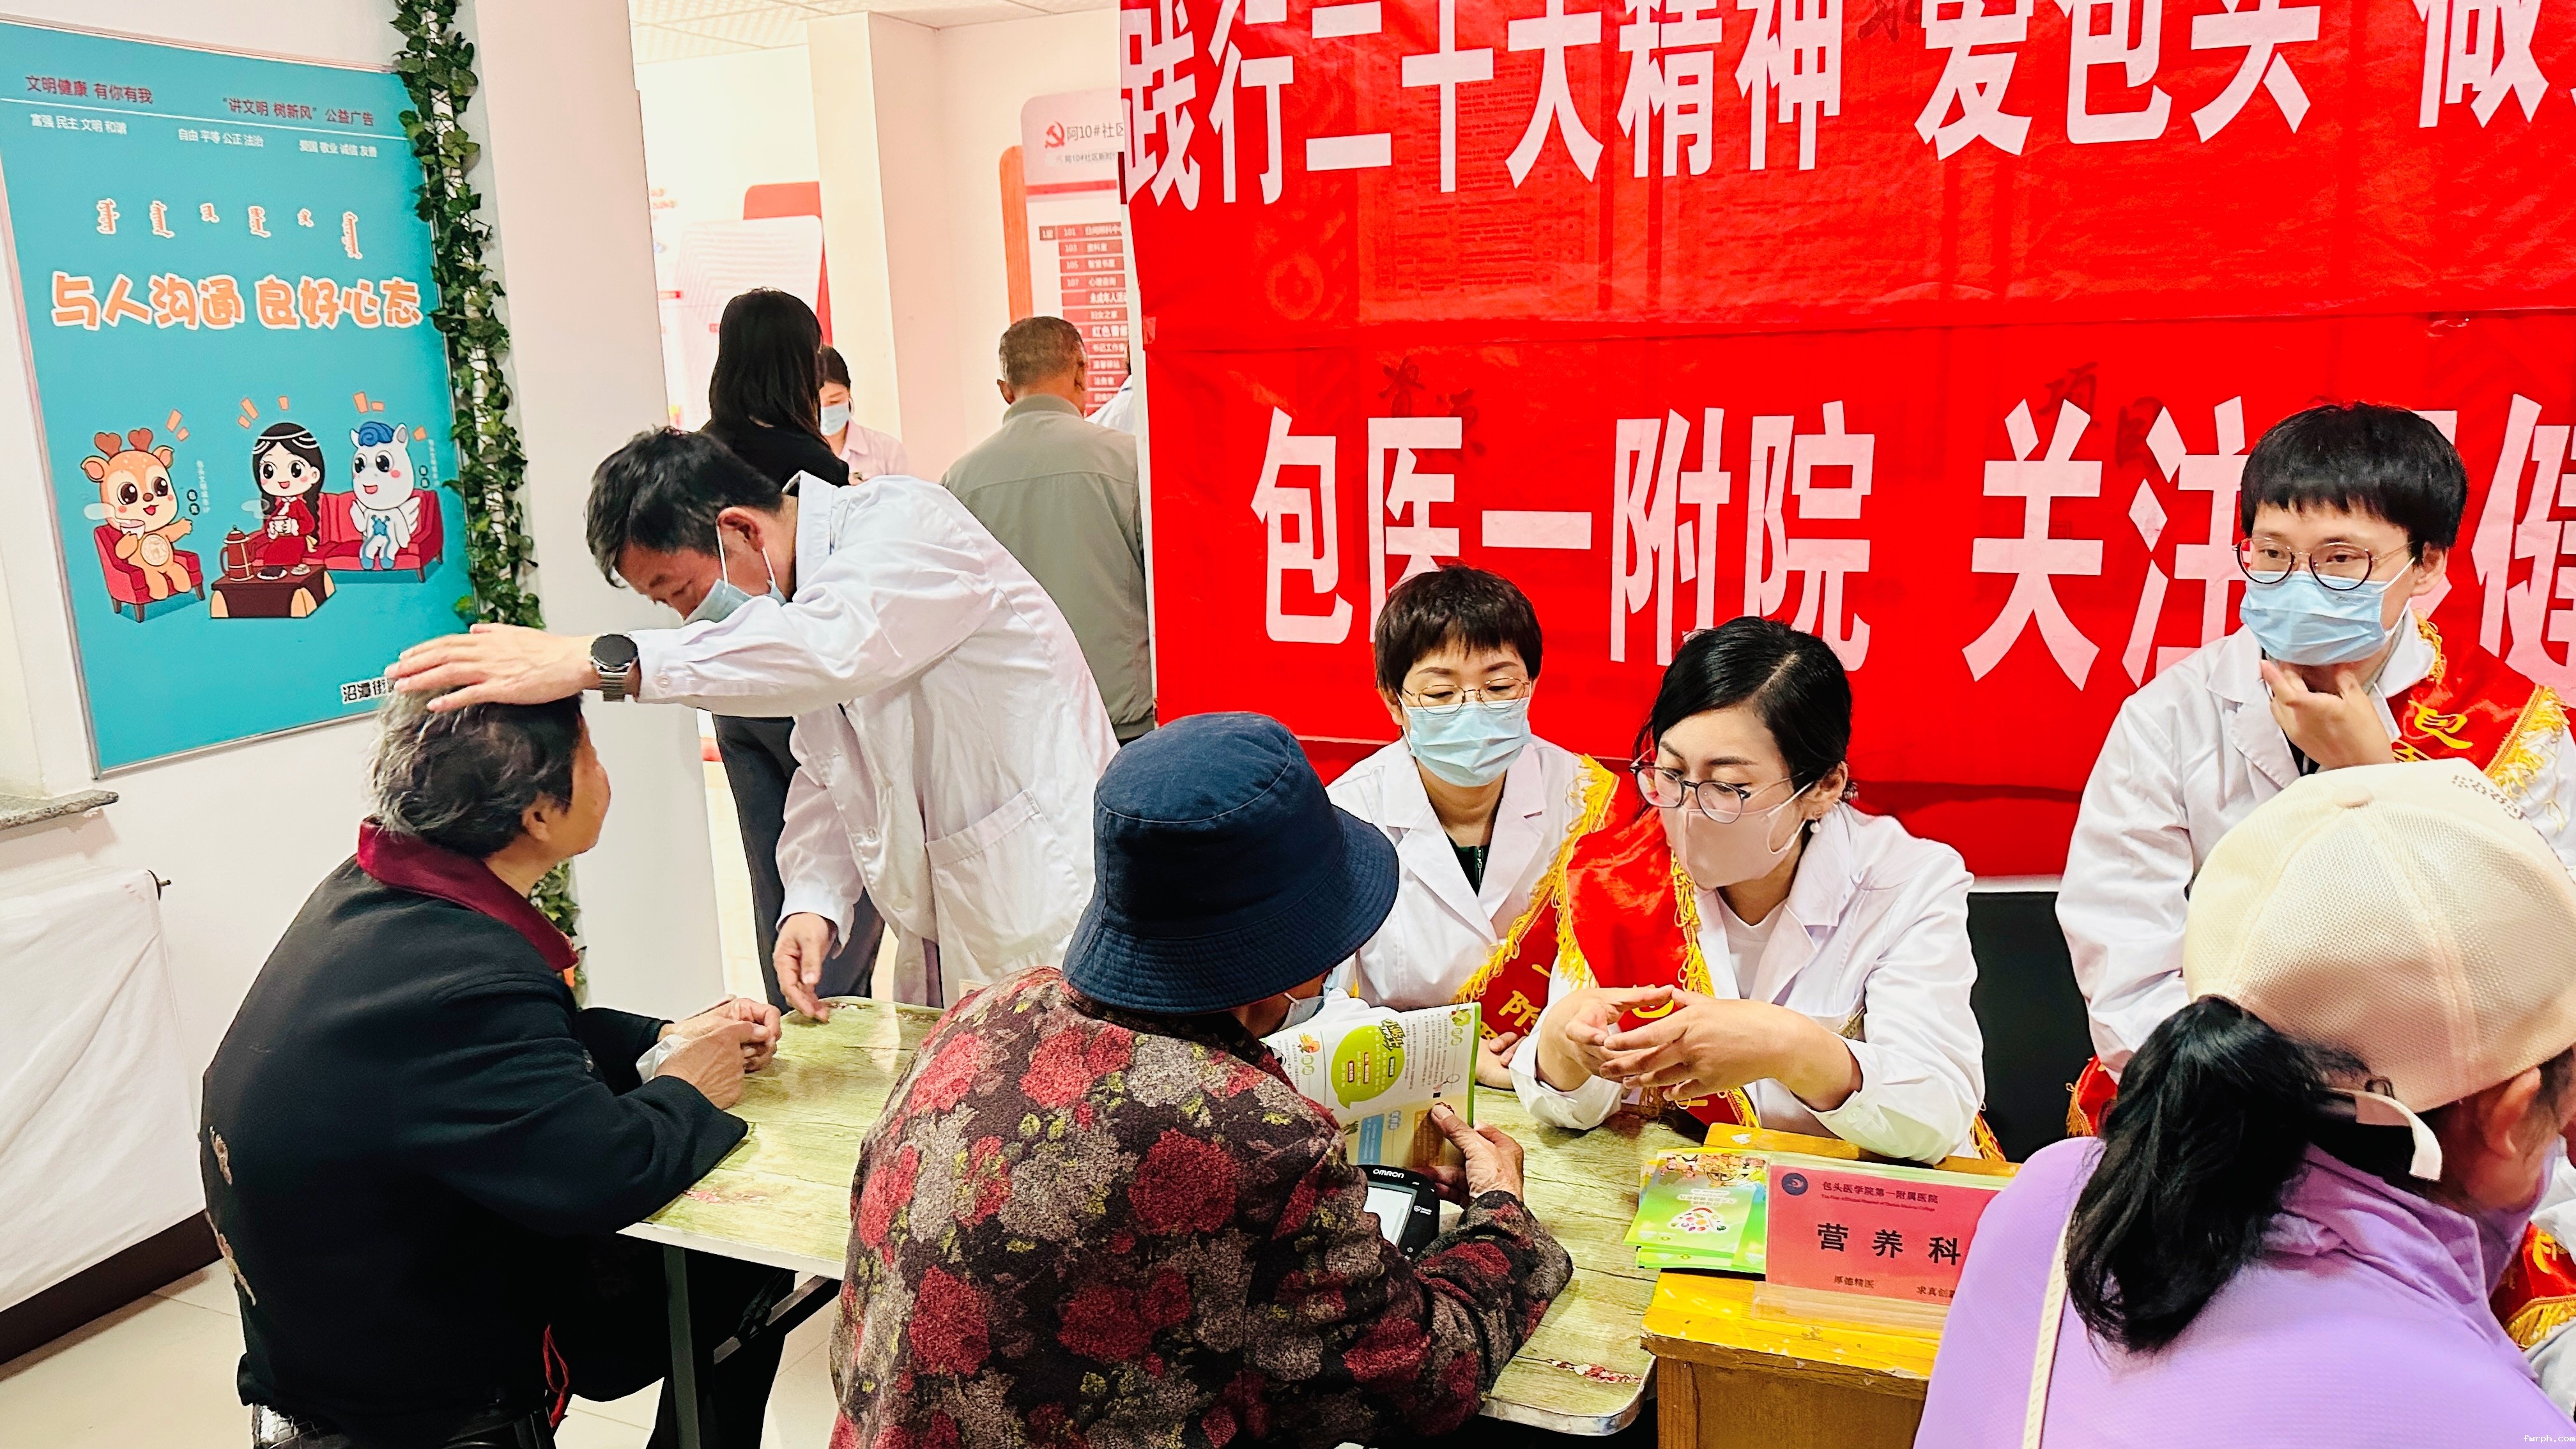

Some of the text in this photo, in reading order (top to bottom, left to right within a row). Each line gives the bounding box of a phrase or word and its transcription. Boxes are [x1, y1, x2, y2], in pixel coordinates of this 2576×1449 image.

[25, 75, 153, 104] 文明健康 有你有我
[1121, 0, 1841, 210] 践行二十大精神
[1914, 0, 2321, 161] 爱包头
[2412, 0, 2576, 128] 做
[31, 114, 54, 128] 富强
[56, 116, 79, 130] 民主
[81, 118, 103, 133] 文明
[325, 108, 374, 126] 公益广告
[178, 128, 264, 147] 自由 平等 公正 法治
[1066, 122, 1124, 141] 阿10#社区
[53, 272, 423, 330] 与人沟通 良好心态
[1090, 292, 1127, 303] 未成年人活
[1250, 400, 1874, 671] 包医一附院
[1961, 394, 2576, 708] 关注健
[1373, 1169, 1404, 1179] OMRON
[1823, 1181, 1938, 1204] 包头医学院第一附属医院
[1817, 1222, 1961, 1266] 营养科
